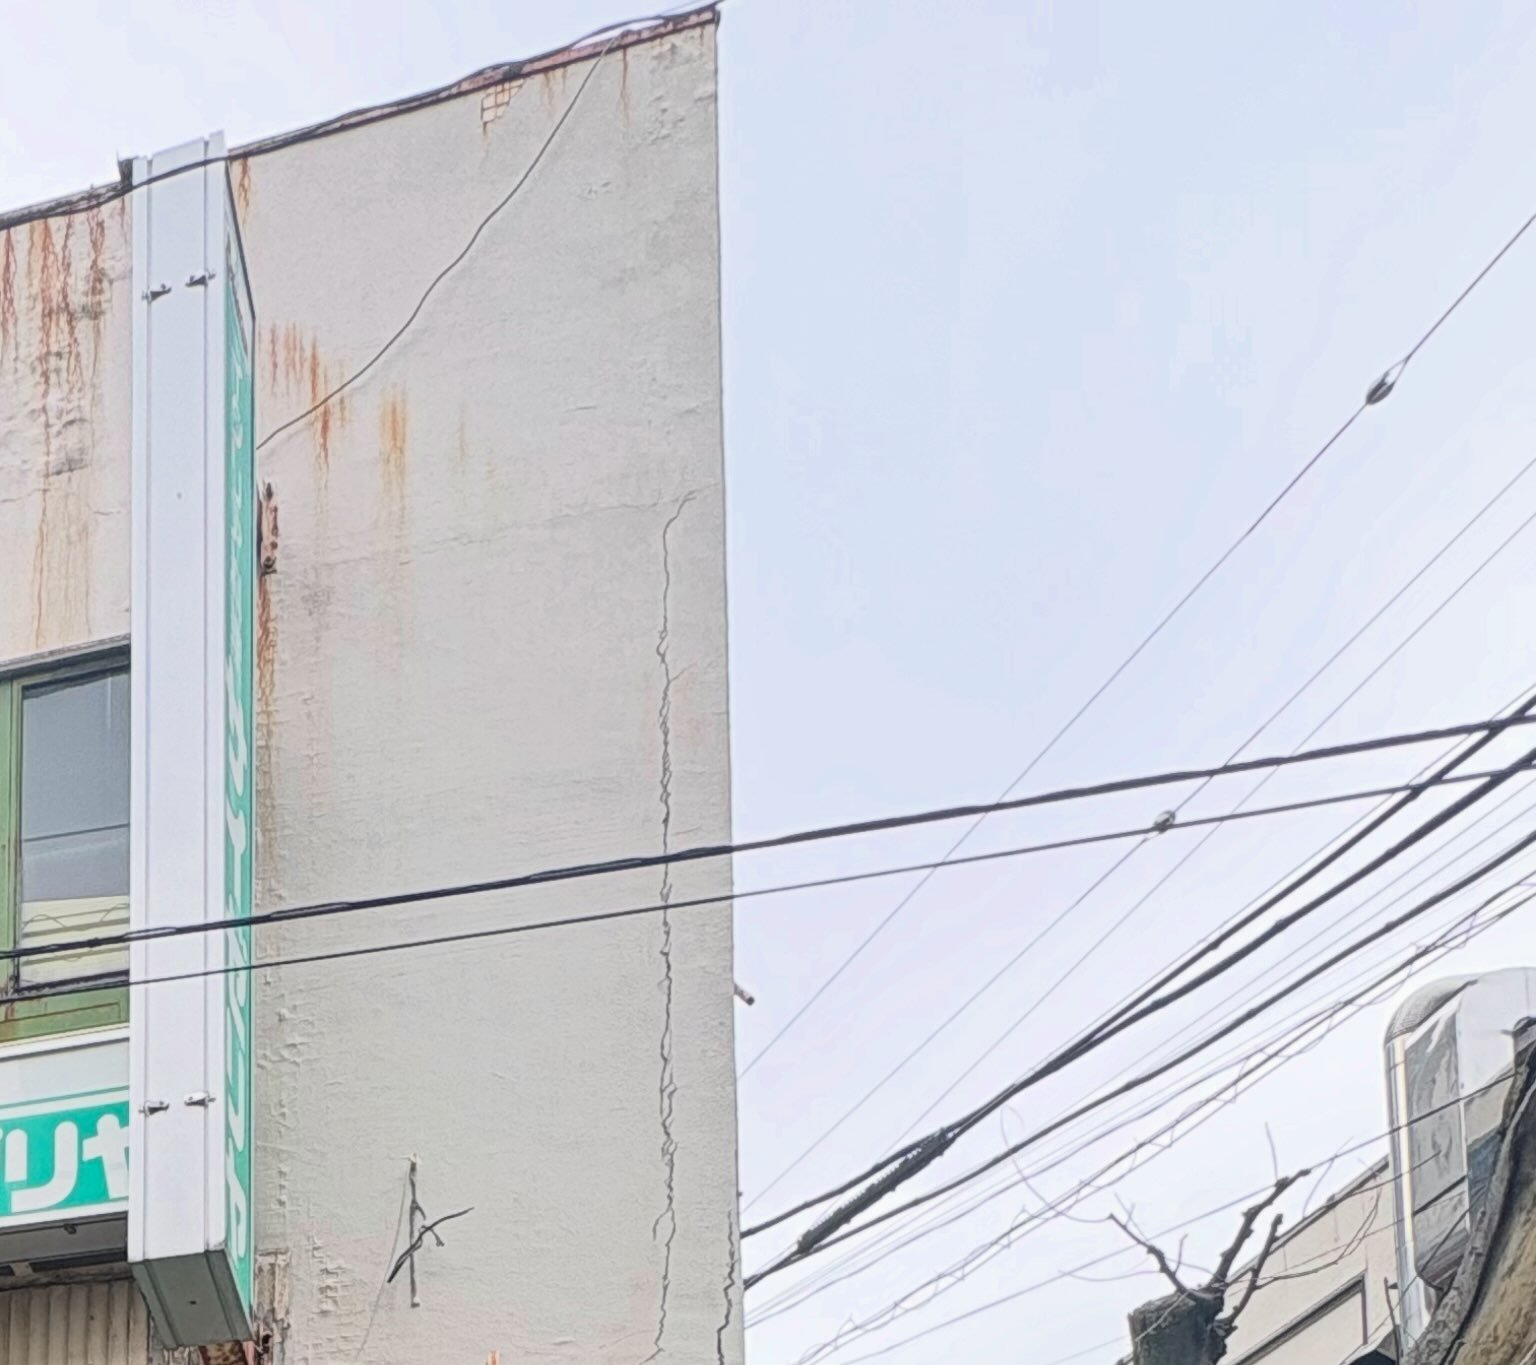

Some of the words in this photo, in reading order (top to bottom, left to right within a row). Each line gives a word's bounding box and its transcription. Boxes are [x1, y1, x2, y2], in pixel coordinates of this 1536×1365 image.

[226, 656, 247, 1260] サイゼリヤ
